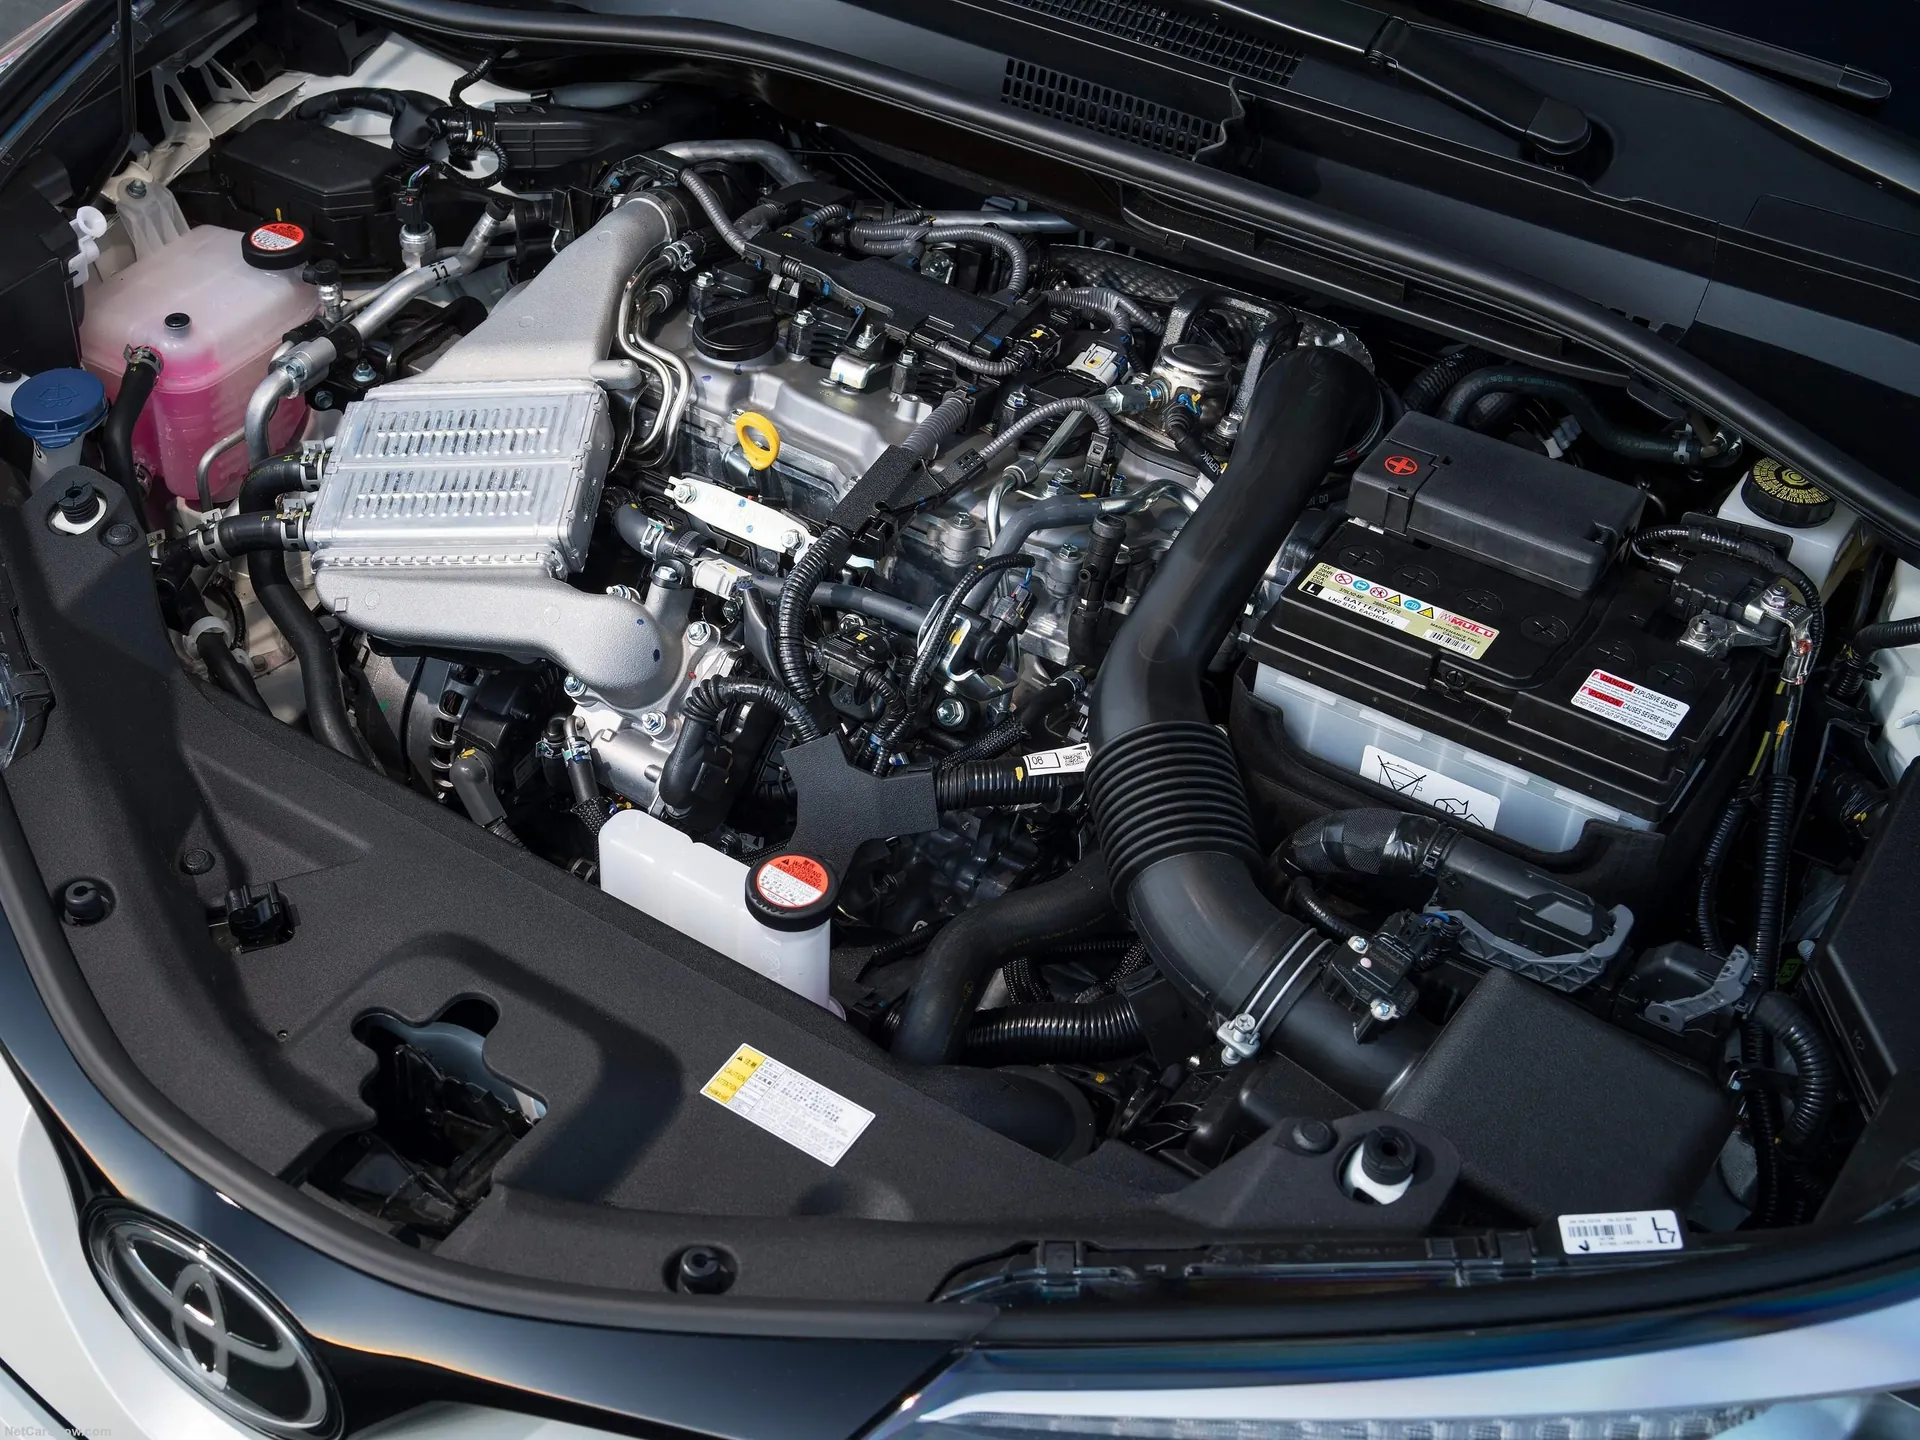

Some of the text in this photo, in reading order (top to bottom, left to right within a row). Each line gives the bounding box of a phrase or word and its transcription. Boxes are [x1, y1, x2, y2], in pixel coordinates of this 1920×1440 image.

[432, 264, 451, 281] 11
[1307, 584, 1316, 593] L
[1327, 596, 1342, 604] LN2
[1357, 608, 1396, 625] EACHCELL
[1342, 595, 1388, 616] BATTERY
[1429, 622, 1466, 638] MAINTENANCE
[1466, 636, 1481, 644] FREE
[1634, 688, 1661, 703] EXPLOSIVE
[1660, 699, 1678, 709] GASES
[1594, 706, 1605, 714] KEEP
[1605, 710, 1614, 718] OUT
[1628, 719, 1642, 728] REACH
[1648, 727, 1667, 739] CHILDREN
[1622, 703, 1641, 714] CAUSES
[1641, 711, 1660, 722] SEVERE
[1659, 718, 1676, 729] BURNS
[1032, 756, 1044, 765] 08
[792, 860, 821, 878] WARNING
[724, 1067, 746, 1082] CAUTION
